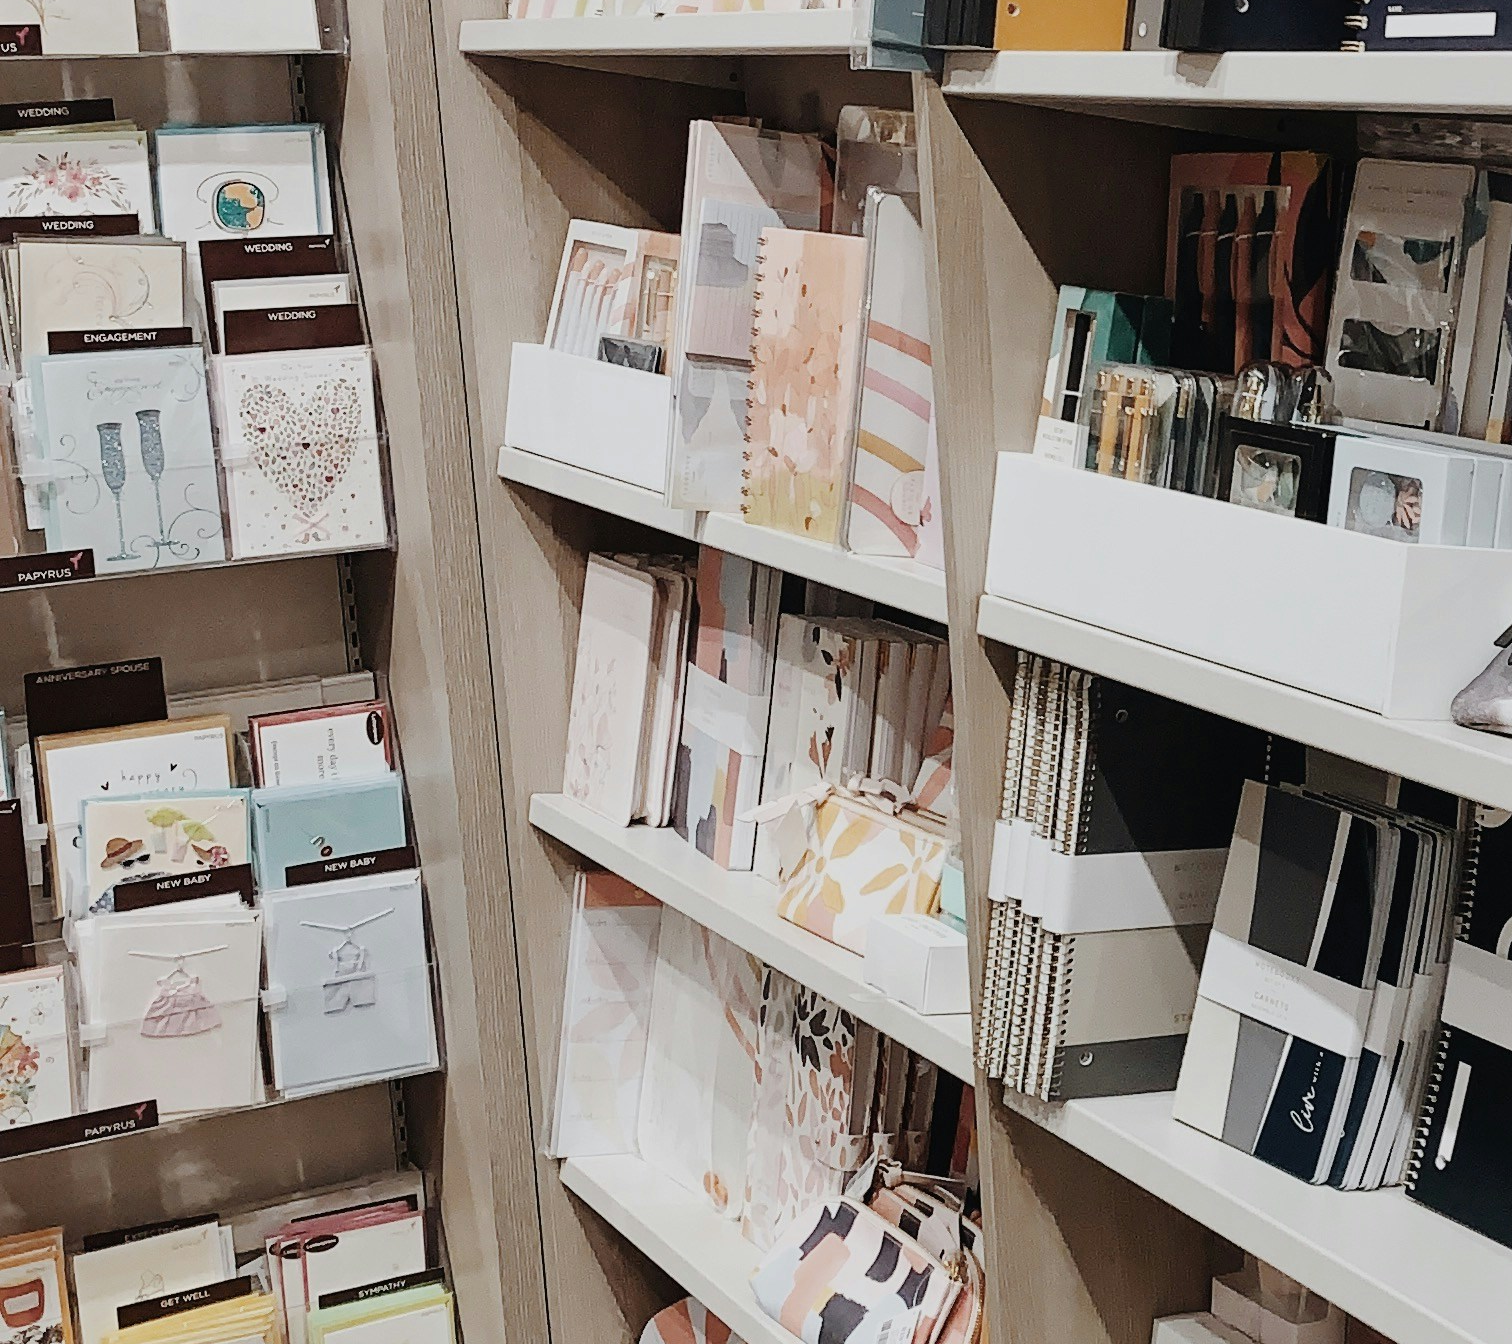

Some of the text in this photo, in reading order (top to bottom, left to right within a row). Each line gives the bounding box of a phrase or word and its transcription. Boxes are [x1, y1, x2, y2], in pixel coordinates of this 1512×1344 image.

[17, 107, 69, 118] WEDDING
[42, 220, 95, 231] WEDDING
[244, 242, 294, 254] WEDDING
[267, 310, 317, 321] WEDDING
[84, 331, 158, 343] ENGAGEMENT
[17, 568, 72, 582] PAPYRUS
[36, 662, 150, 684] ANNIVERSARY SPOUSE
[325, 856, 376, 873] NEW BABY
[156, 873, 211, 890] NEW BABY
[85, 1120, 136, 1138] PAPYRUS
[357, 1279, 406, 1299] SYMPATHY
[160, 1289, 211, 1309] GET WELL
